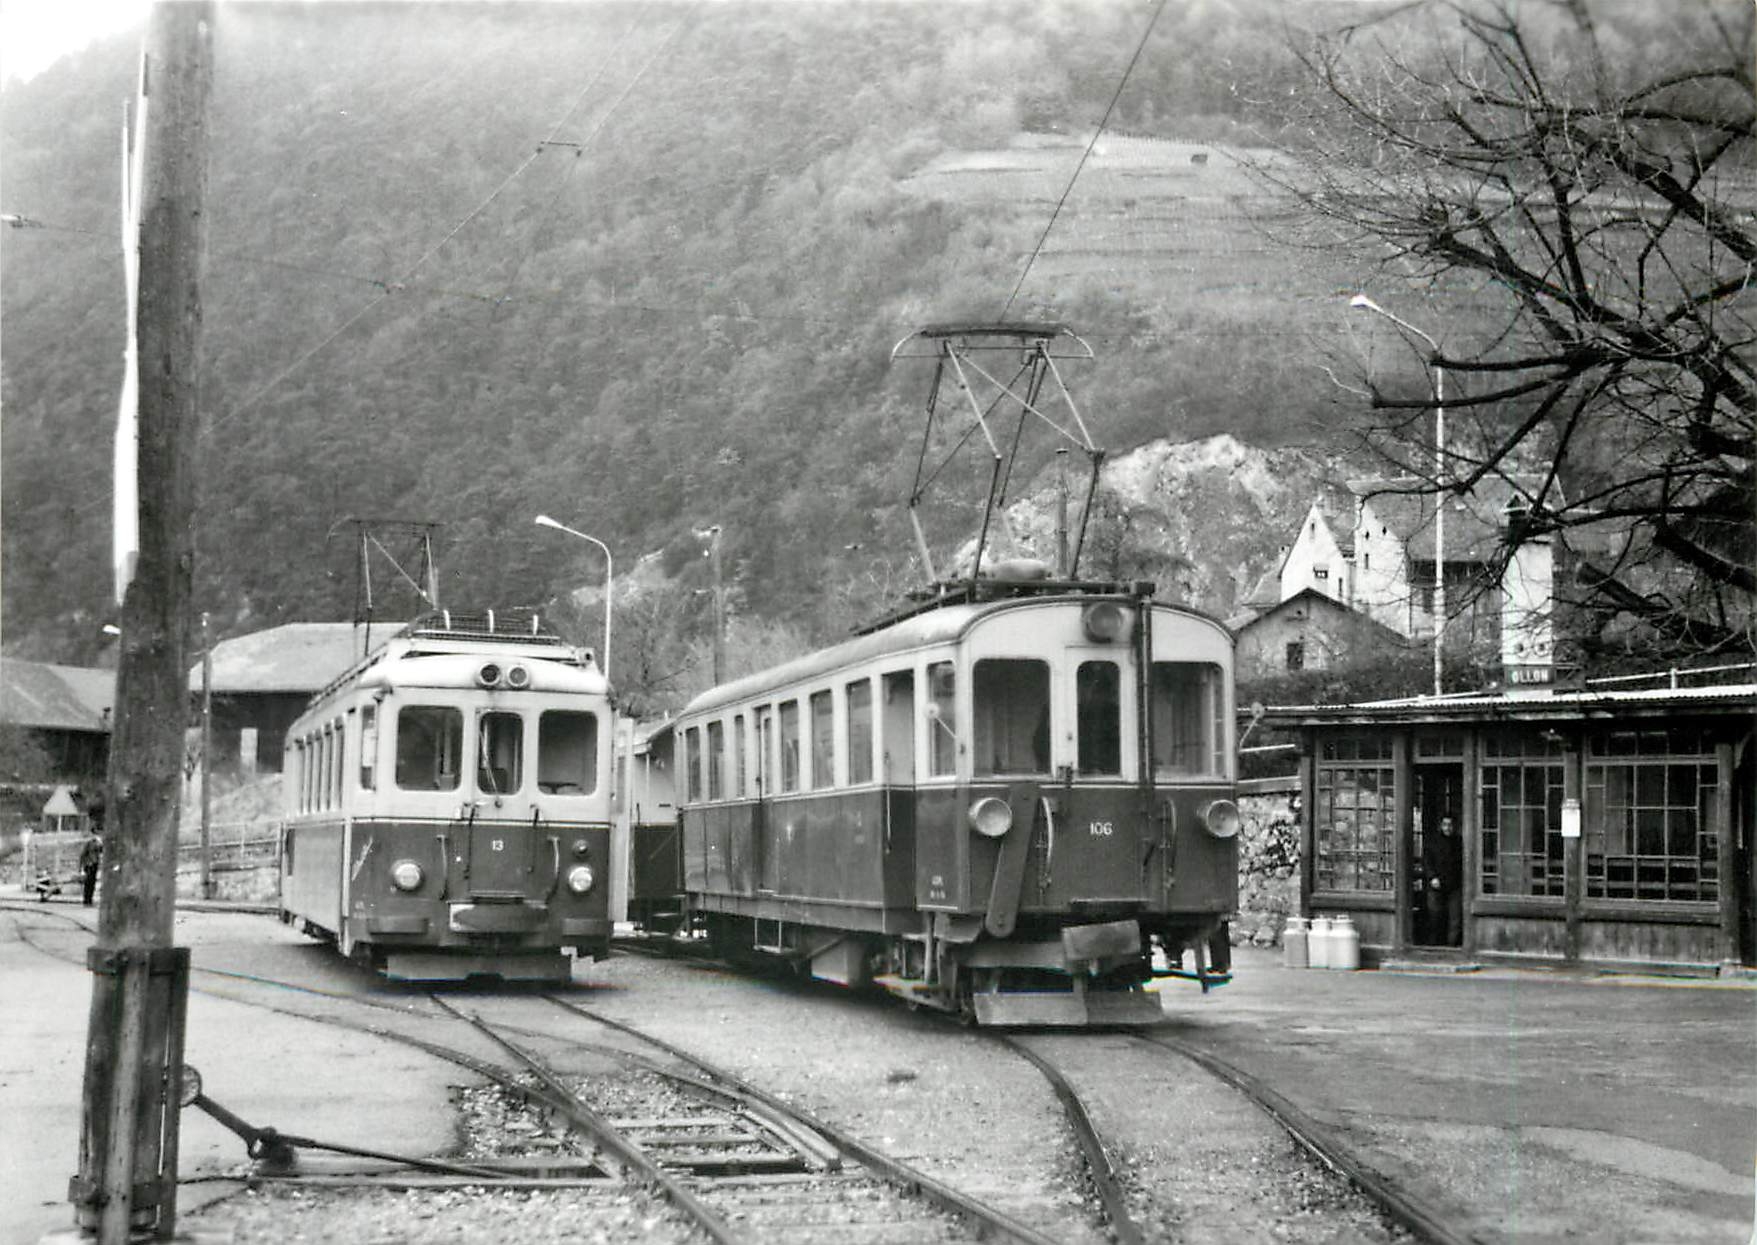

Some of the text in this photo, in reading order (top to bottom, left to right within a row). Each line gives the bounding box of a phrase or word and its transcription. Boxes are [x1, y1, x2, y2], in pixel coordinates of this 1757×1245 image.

[1511, 669, 1549, 683] OLLON
[1090, 821, 1113, 836] 106
[492, 839, 504, 851] 13
